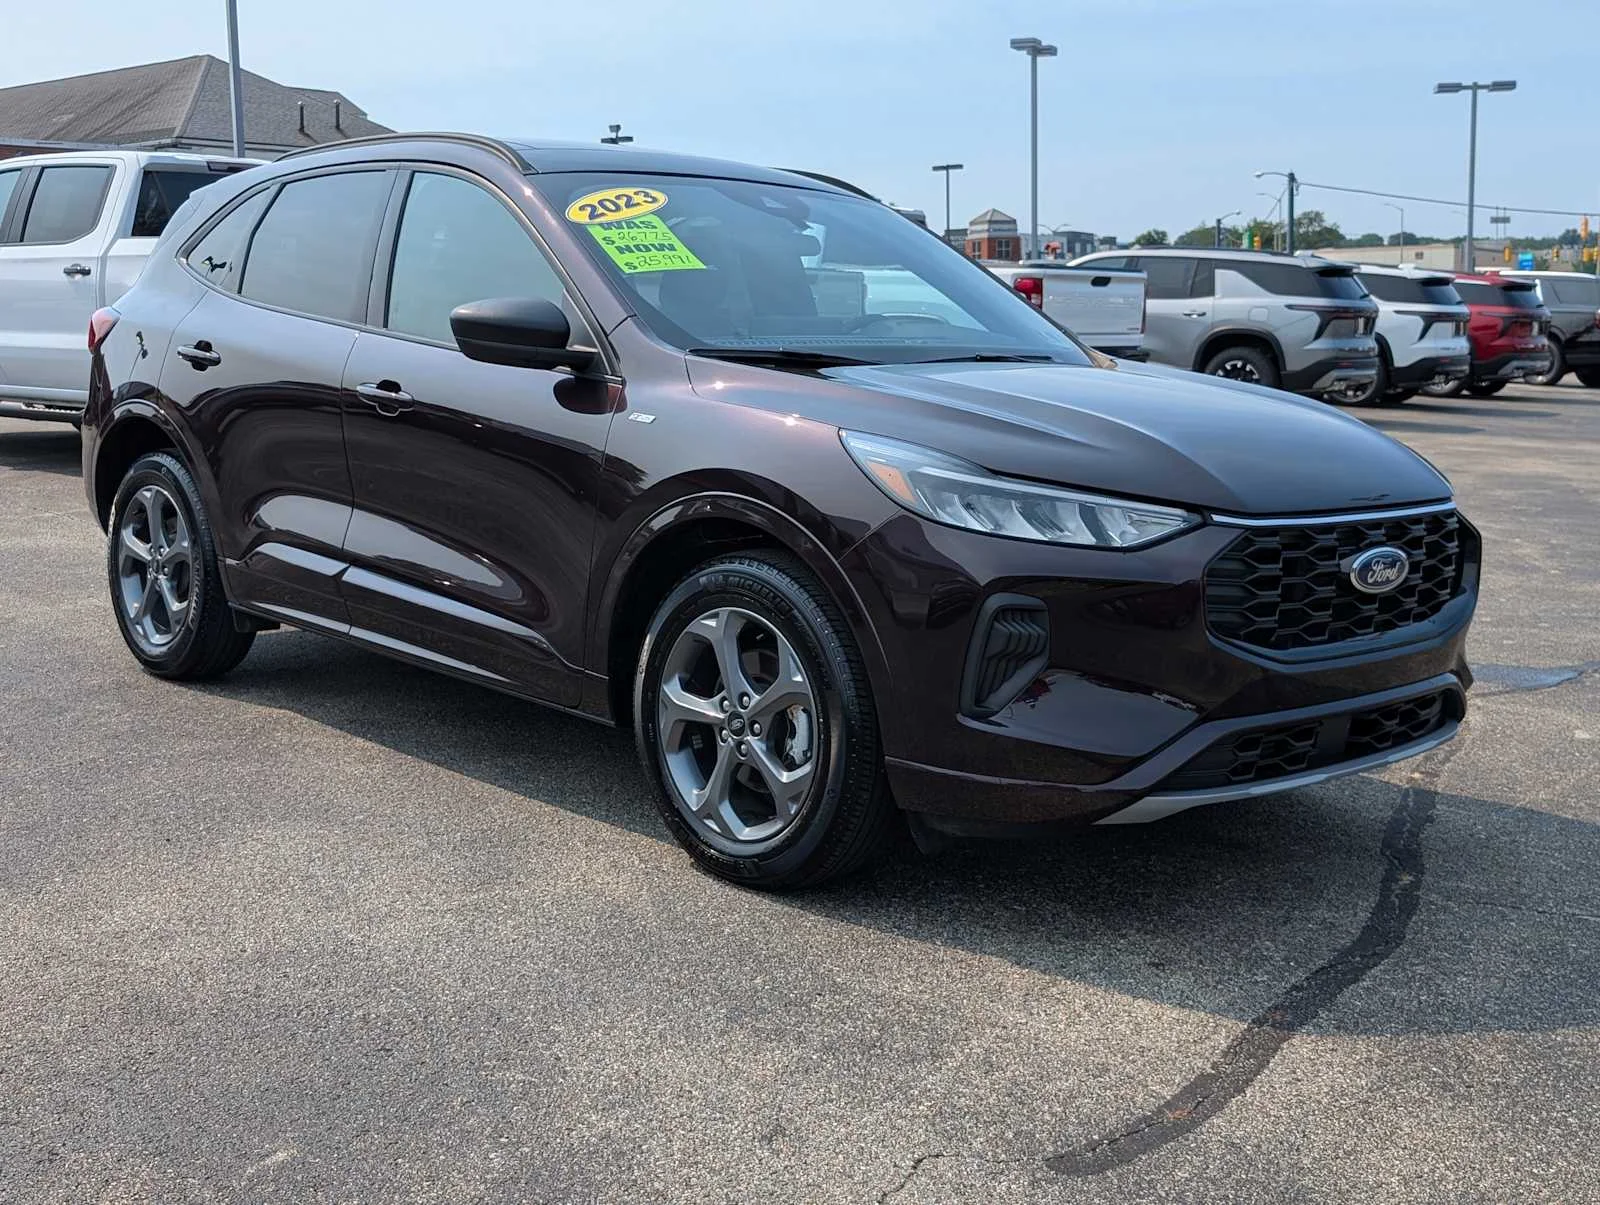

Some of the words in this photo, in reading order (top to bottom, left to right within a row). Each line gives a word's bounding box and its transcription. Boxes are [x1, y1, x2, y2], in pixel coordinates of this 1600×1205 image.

[579, 190, 658, 220] 2023
[600, 220, 658, 230] WAS
[615, 243, 677, 254] NOW
[1368, 558, 1401, 583] Ford
